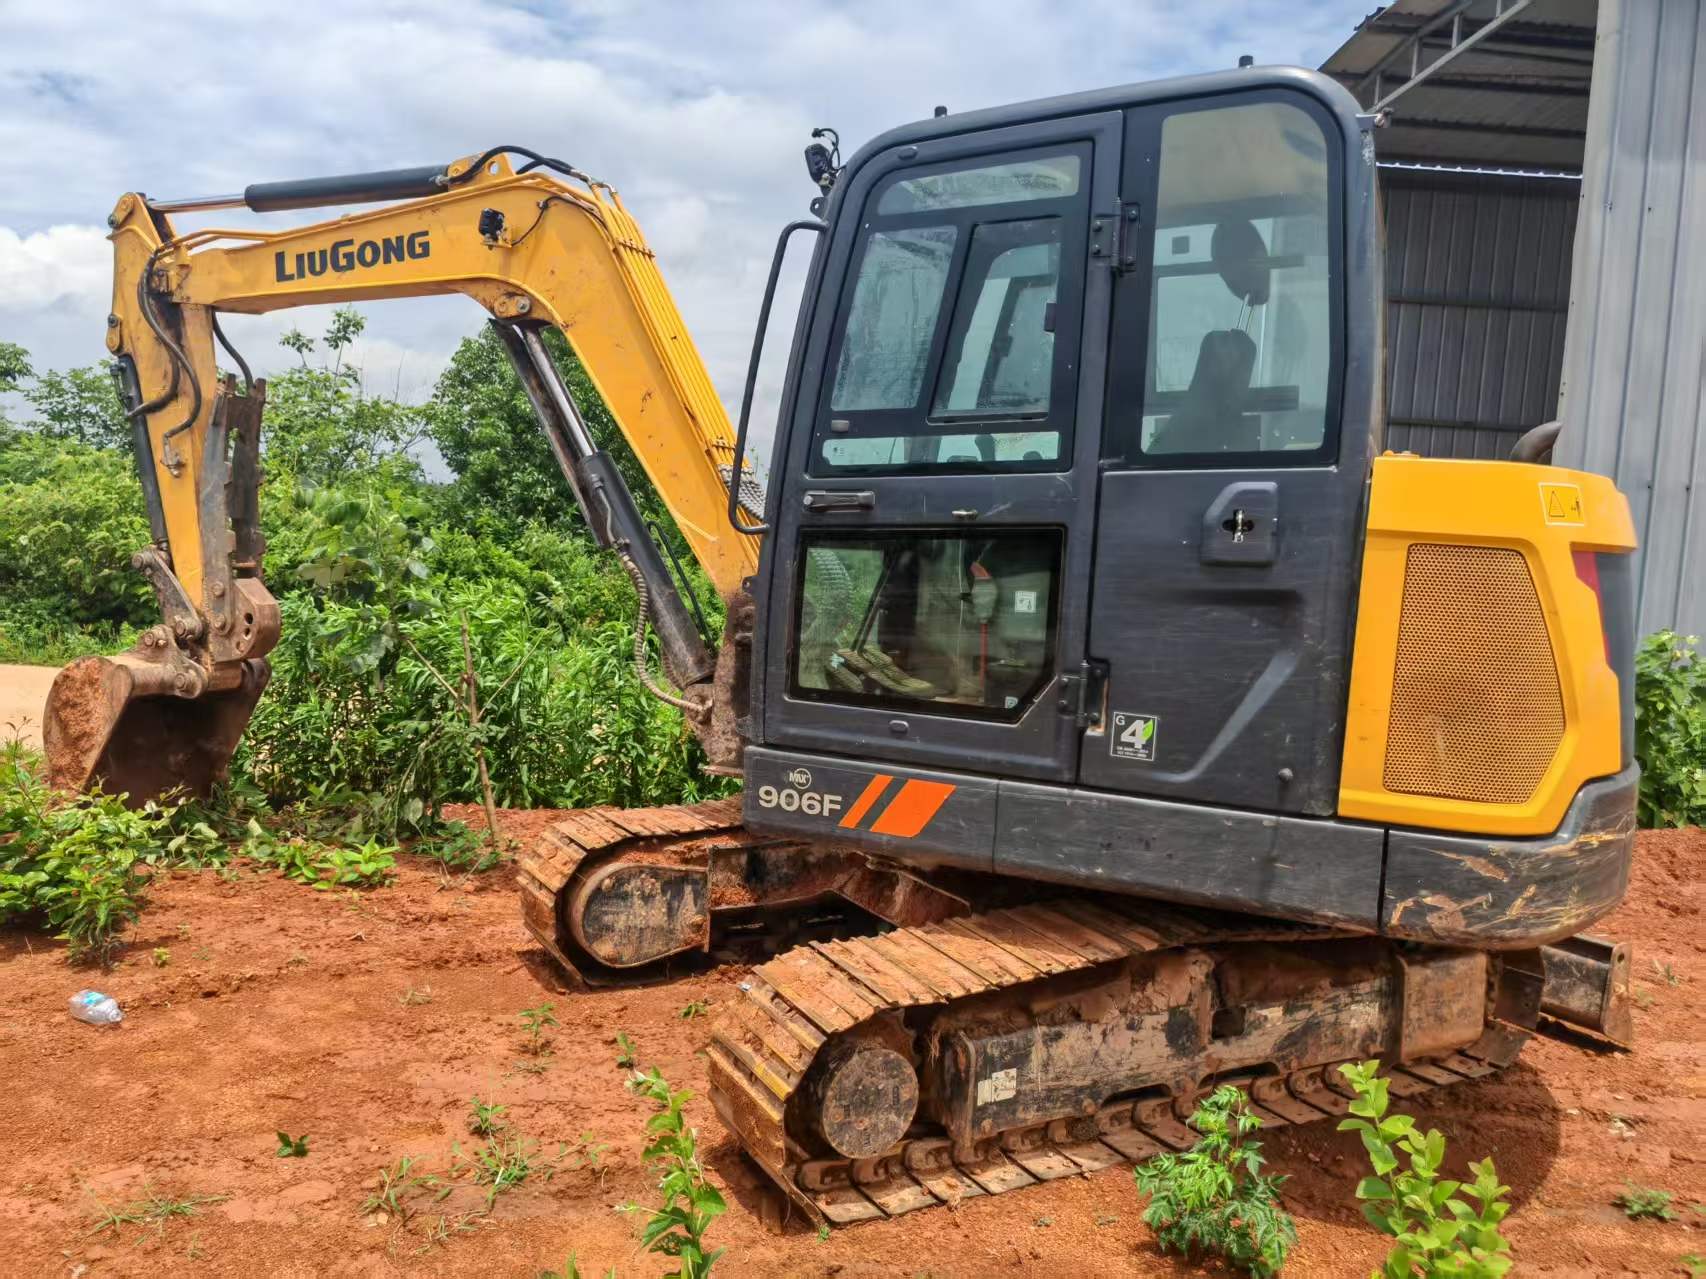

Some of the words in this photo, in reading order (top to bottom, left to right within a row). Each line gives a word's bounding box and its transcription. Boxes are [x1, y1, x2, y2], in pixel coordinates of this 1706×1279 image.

[1115, 715, 1125, 726] G
[1121, 719, 1146, 749] 4
[758, 785, 842, 816] 906F
